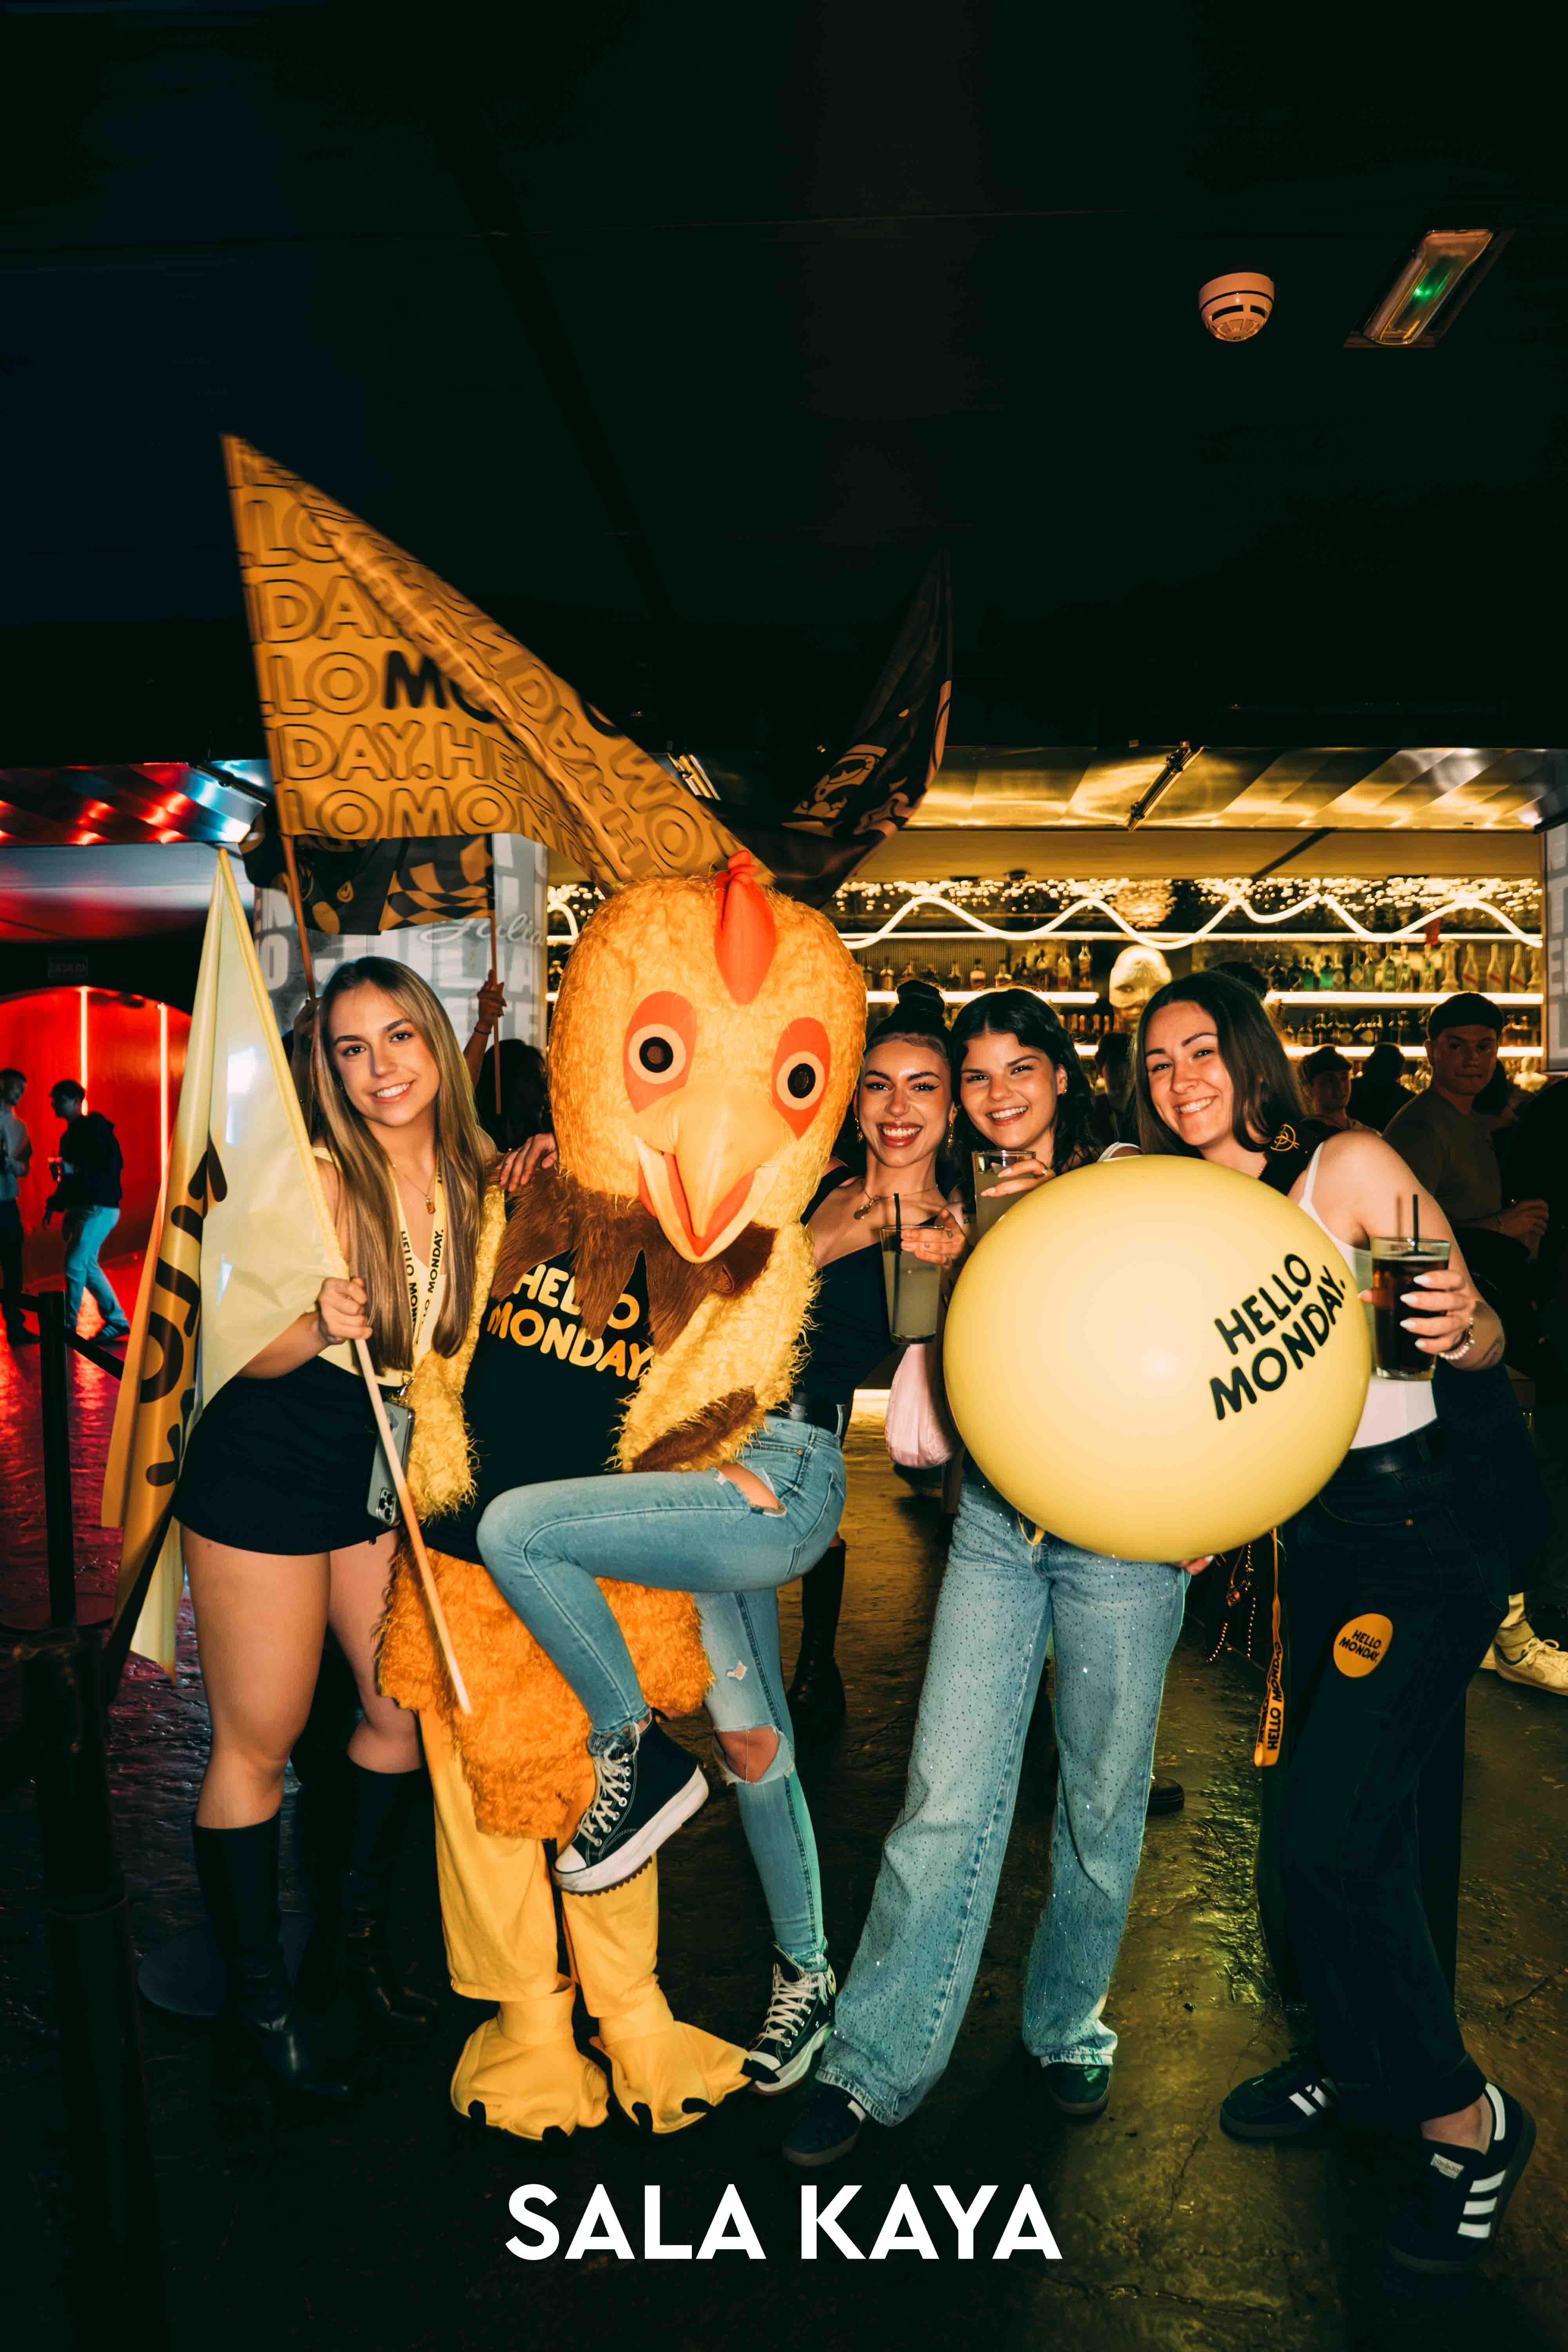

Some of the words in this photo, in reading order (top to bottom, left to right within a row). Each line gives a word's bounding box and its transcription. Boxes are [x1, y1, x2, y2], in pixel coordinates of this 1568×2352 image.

[513, 1264, 640, 1330] HELO
[1214, 1253, 1312, 1355] HELLO
[1209, 1265, 1346, 1421] MONDAY.
[1352, 1629, 1381, 1649] HELLO
[1267, 1707, 1281, 1750] HELLO
